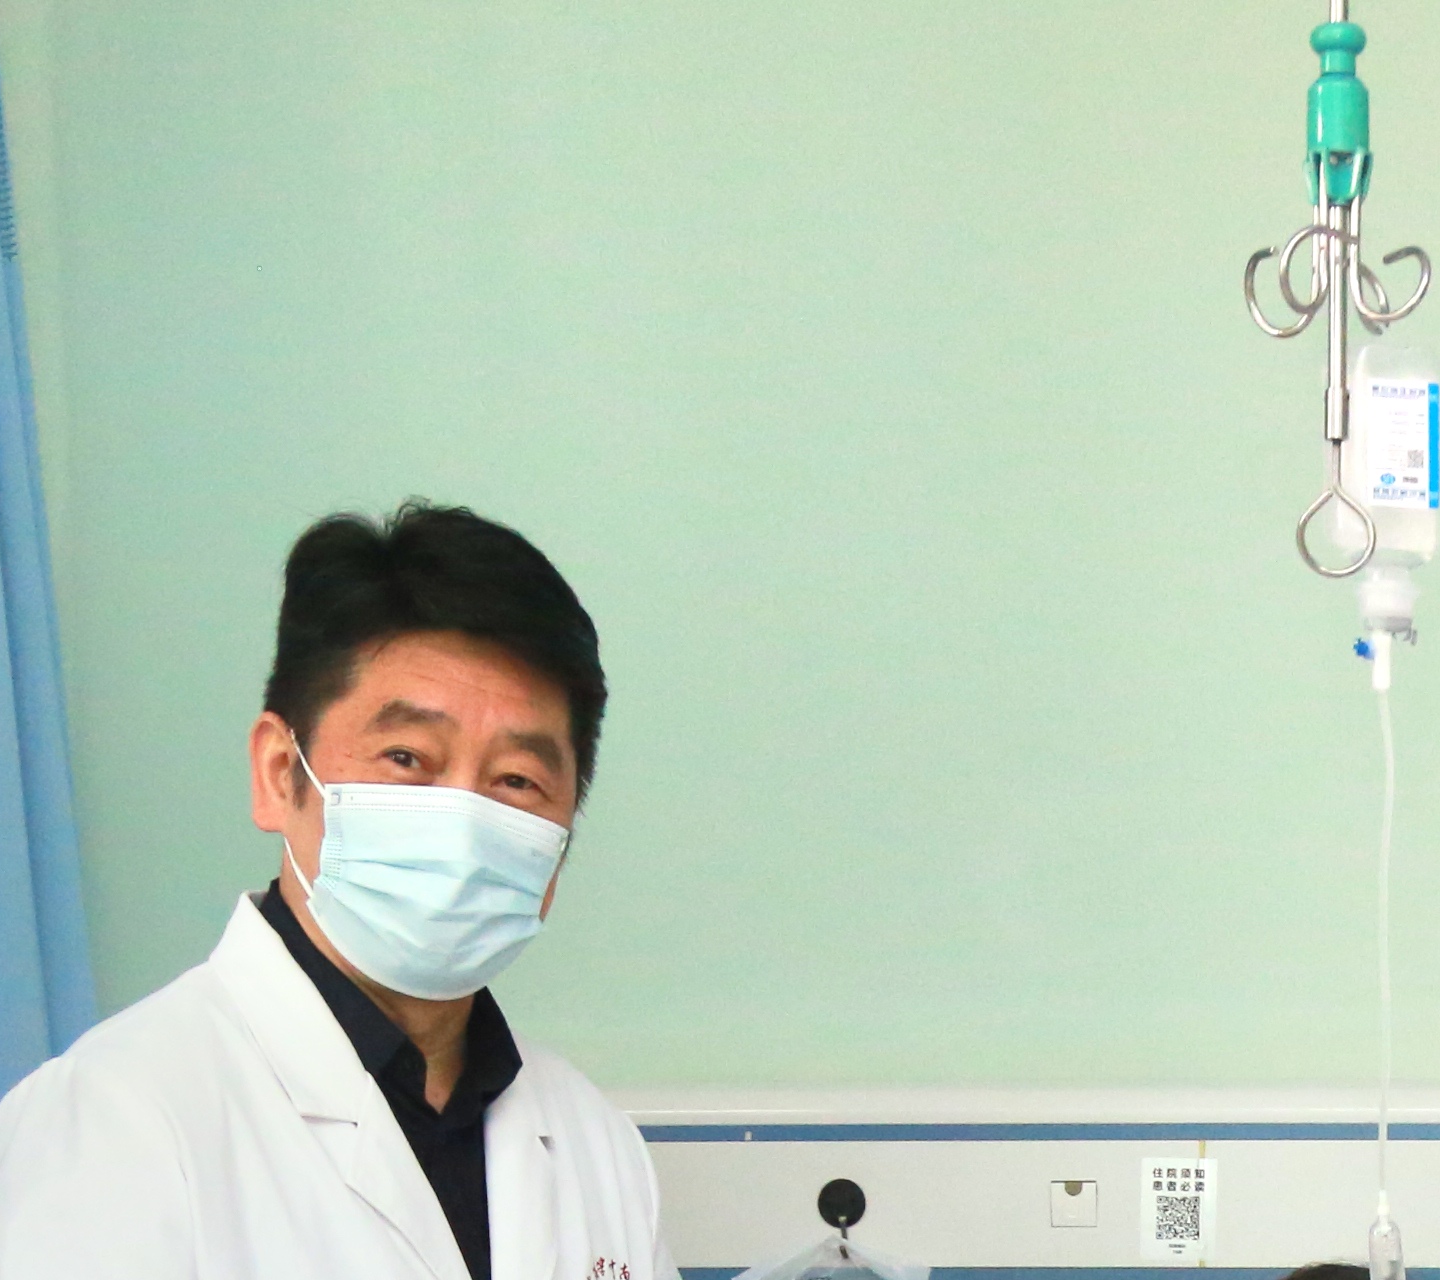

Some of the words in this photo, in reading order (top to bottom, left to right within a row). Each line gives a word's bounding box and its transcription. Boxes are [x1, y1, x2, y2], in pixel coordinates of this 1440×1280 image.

[1152, 1167, 1205, 1179] 住院须知
[1152, 1180, 1205, 1192] 患者必读
